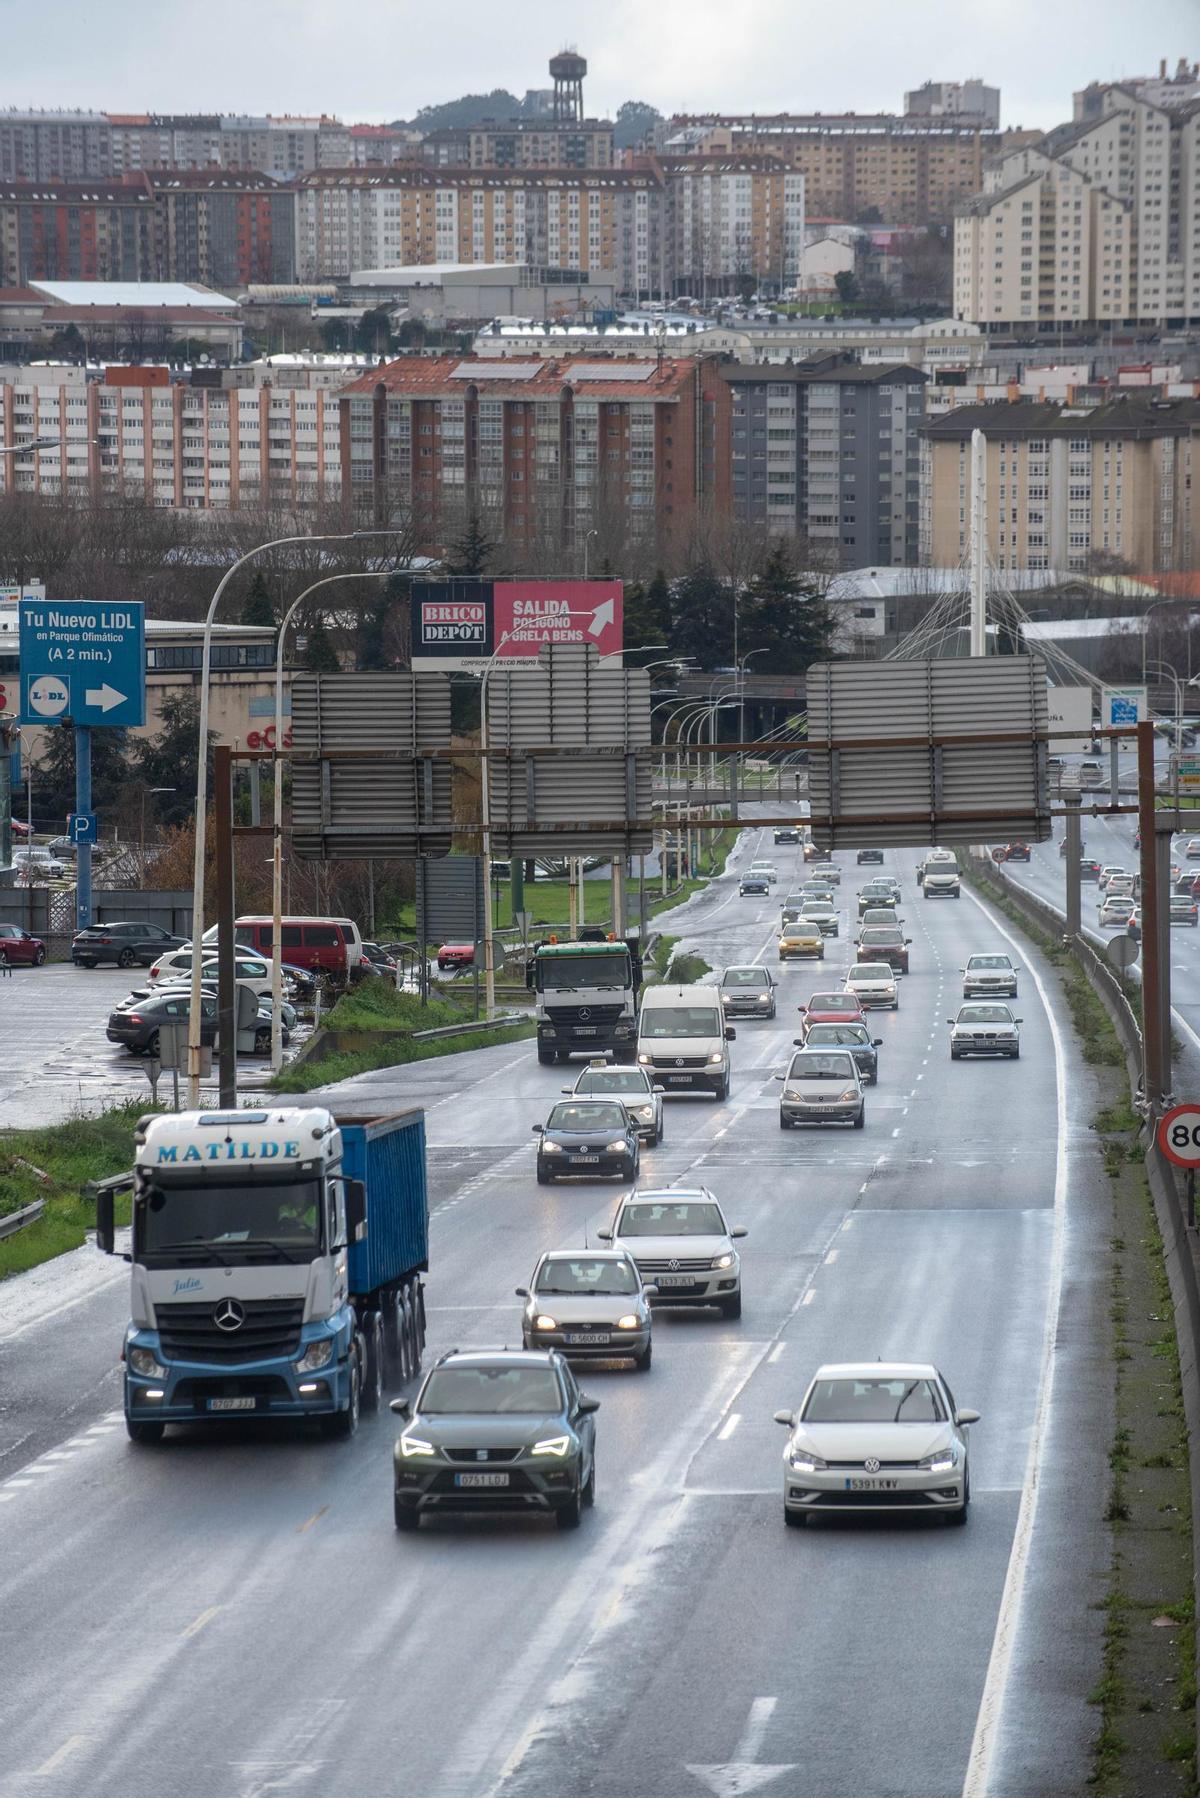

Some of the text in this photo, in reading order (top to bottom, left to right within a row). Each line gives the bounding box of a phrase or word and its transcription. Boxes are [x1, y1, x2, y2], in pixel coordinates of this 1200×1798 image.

[425, 607, 483, 620] BRICO
[512, 600, 569, 615] SALIDA
[24, 611, 136, 629] Tu Nuevo LIDL
[36, 631, 124, 643] en Parque Ofimático
[511, 630, 550, 641] GRELA
[552, 630, 584, 641] BENS
[48, 647, 112, 664] (A 2 min.)
[75, 816, 90, 841] P
[157, 1141, 300, 1163] MATILDE
[851, 1479, 876, 1489] 5391
